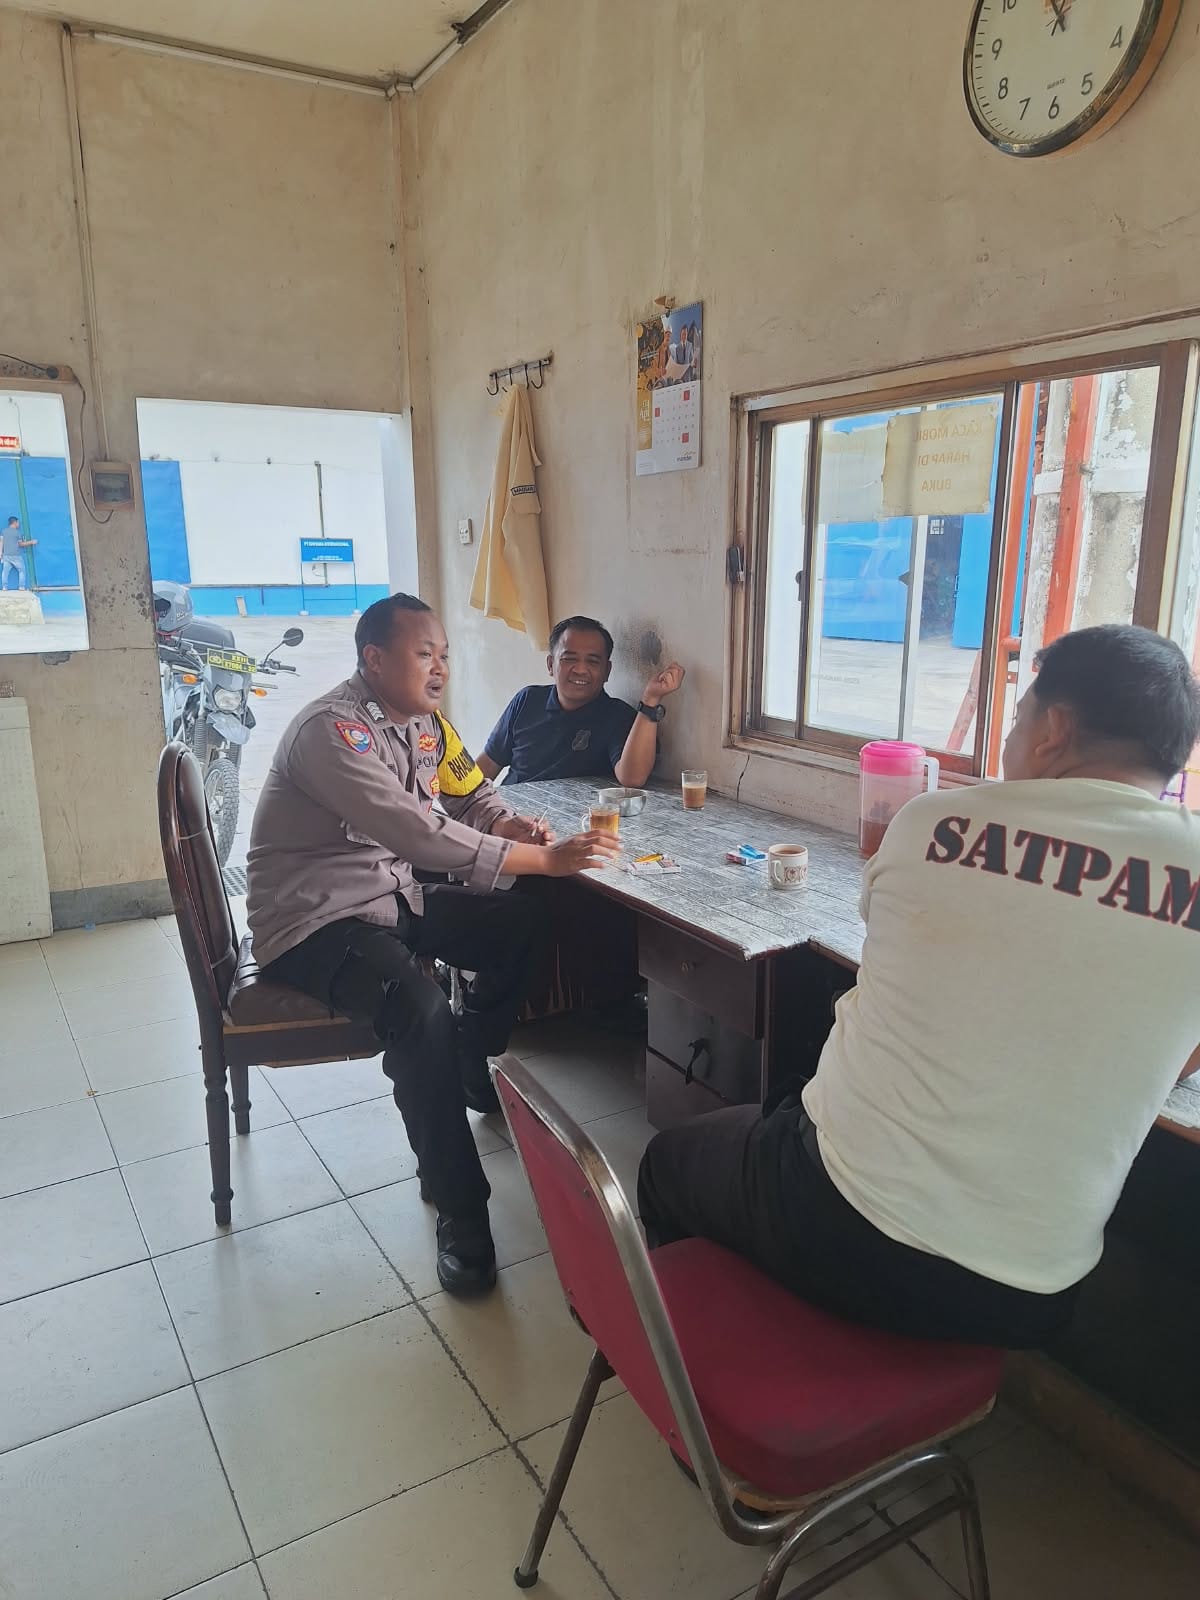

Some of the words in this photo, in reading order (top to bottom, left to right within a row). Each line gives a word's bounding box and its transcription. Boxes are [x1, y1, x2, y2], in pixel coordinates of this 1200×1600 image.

[991, 38, 1002, 60] 9
[1109, 26, 1123, 49] 4
[998, 77, 1008, 99] 8
[1081, 72, 1093, 95] 5
[1019, 97, 1031, 120] 7
[1048, 96, 1060, 119] 6
[925, 815, 1200, 932] SATPAM
